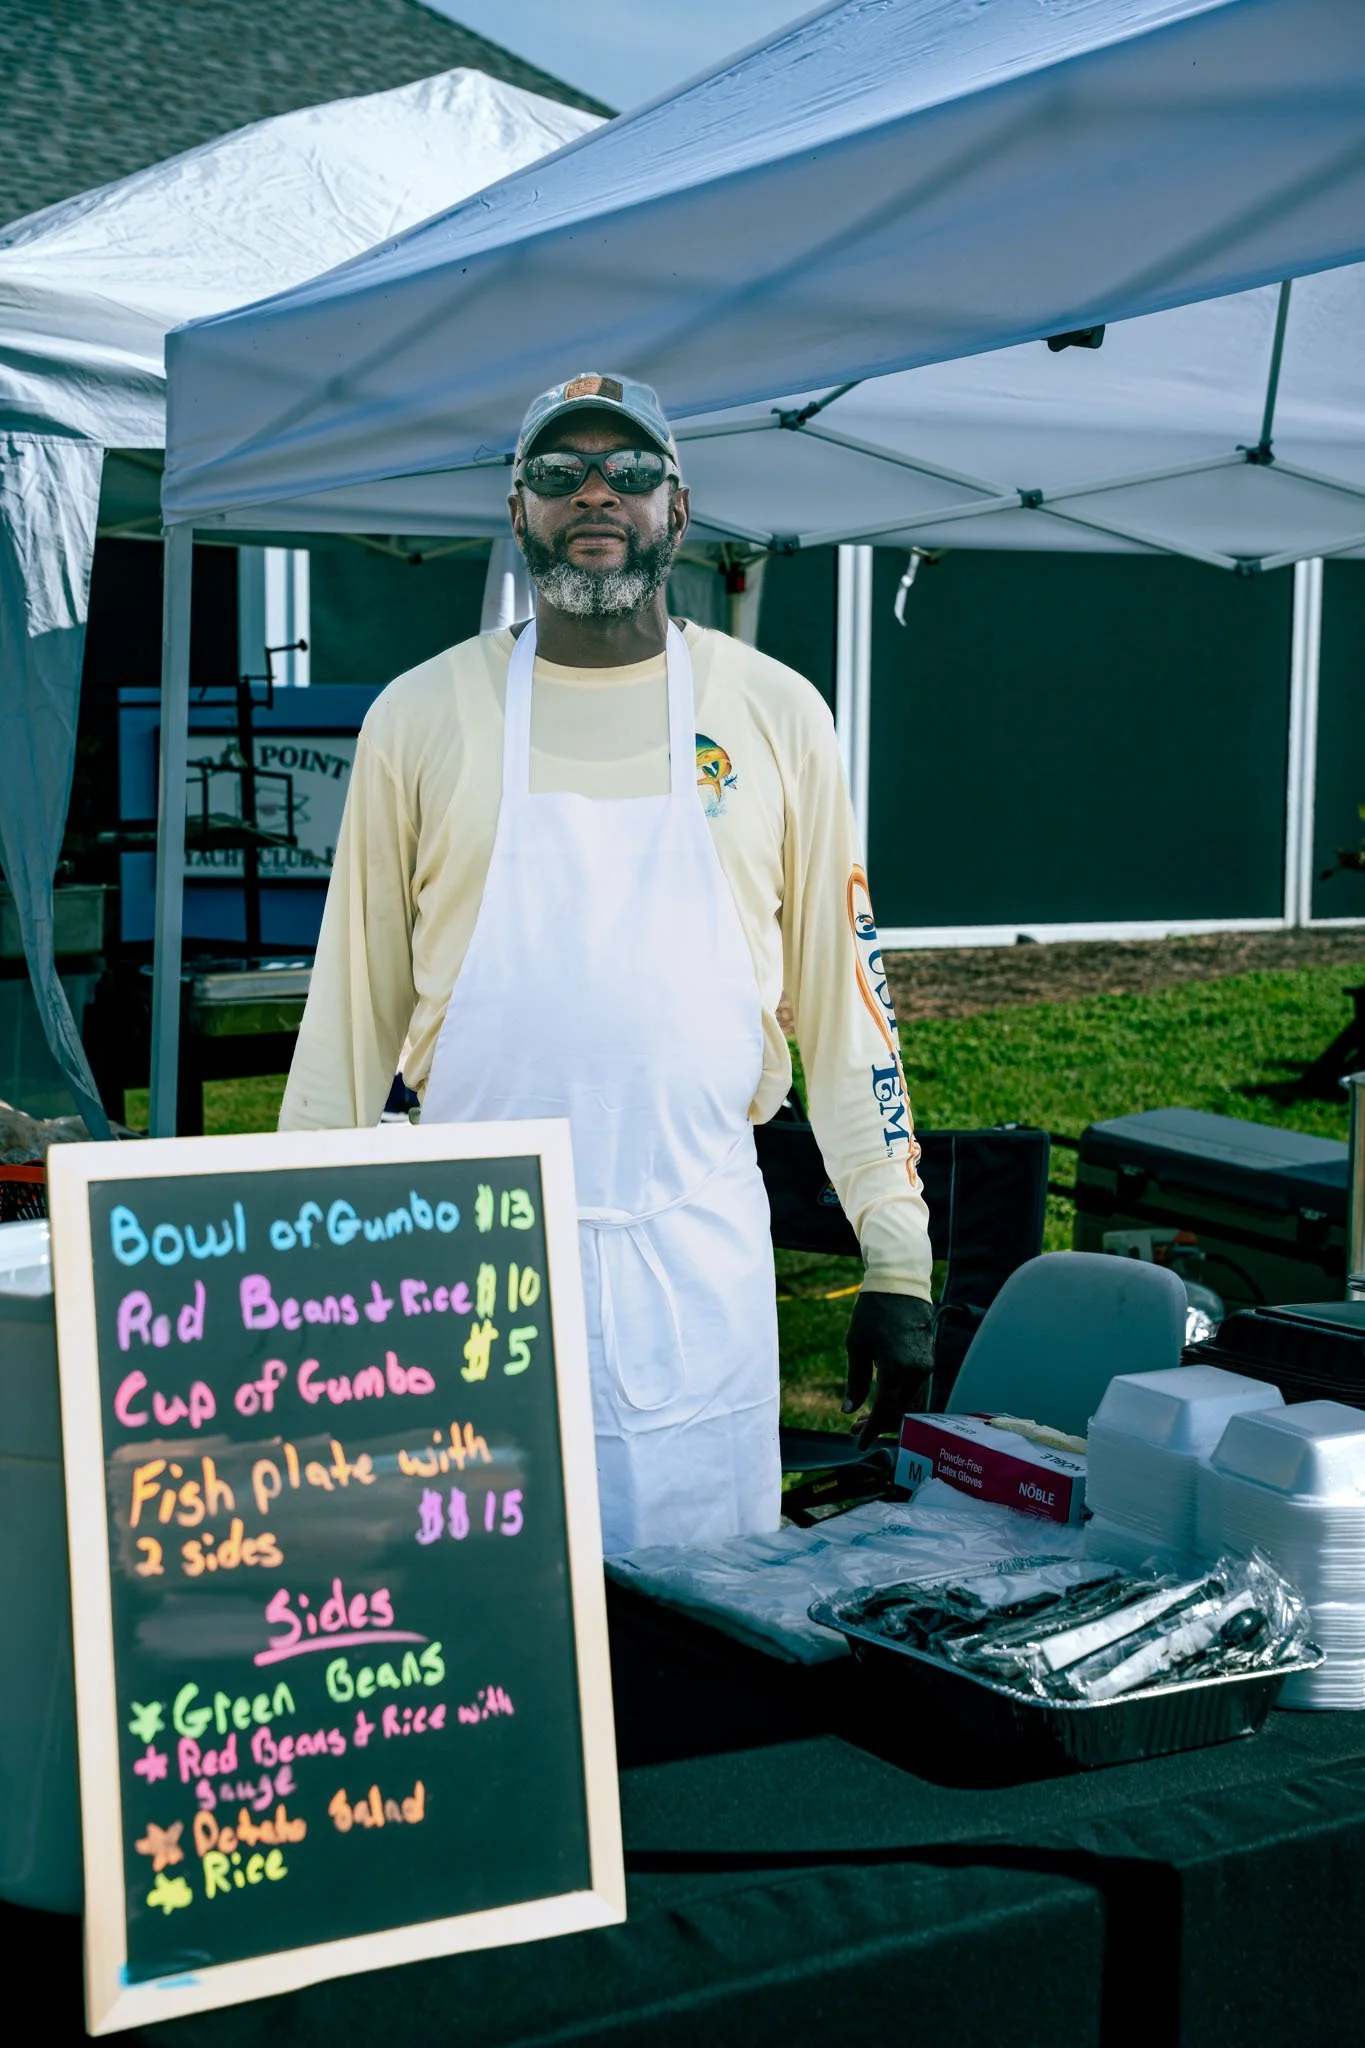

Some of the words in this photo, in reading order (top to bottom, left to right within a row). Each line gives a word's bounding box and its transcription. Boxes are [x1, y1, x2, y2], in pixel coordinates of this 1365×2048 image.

[259, 745, 350, 781] POINT
[184, 848, 243, 868] YACH
[110, 1201, 246, 1266] Bowl
[270, 1201, 323, 1250] of
[327, 1189, 460, 1245] Gumbo
[240, 1274, 359, 1330] Beans
[400, 1278, 473, 1317] Rice
[114, 1369, 216, 1428] Cup
[235, 1359, 287, 1416] of
[297, 1351, 436, 1405] Gumbo
[129, 1456, 236, 1528] Fish
[252, 1439, 377, 1514] plate
[399, 1421, 493, 1478] with
[908, 1460, 922, 1484] M
[937, 1461, 957, 1480] Latex
[958, 1470, 983, 1489] Gloves
[939, 1448, 983, 1475] Powder-Free
[1018, 1481, 1055, 1506] NOBLE
[133, 1536, 164, 1577] 2
[181, 1518, 284, 1577] sides
[264, 1577, 395, 1650] Sides
[172, 1682, 296, 1738] Green
[326, 1641, 446, 1702] Beans
[177, 1732, 238, 1783] Red
[251, 1726, 347, 1767] Beans
[382, 1703, 446, 1738] Rice
[458, 1686, 515, 1725] with
[203, 1848, 288, 1899] Rice
